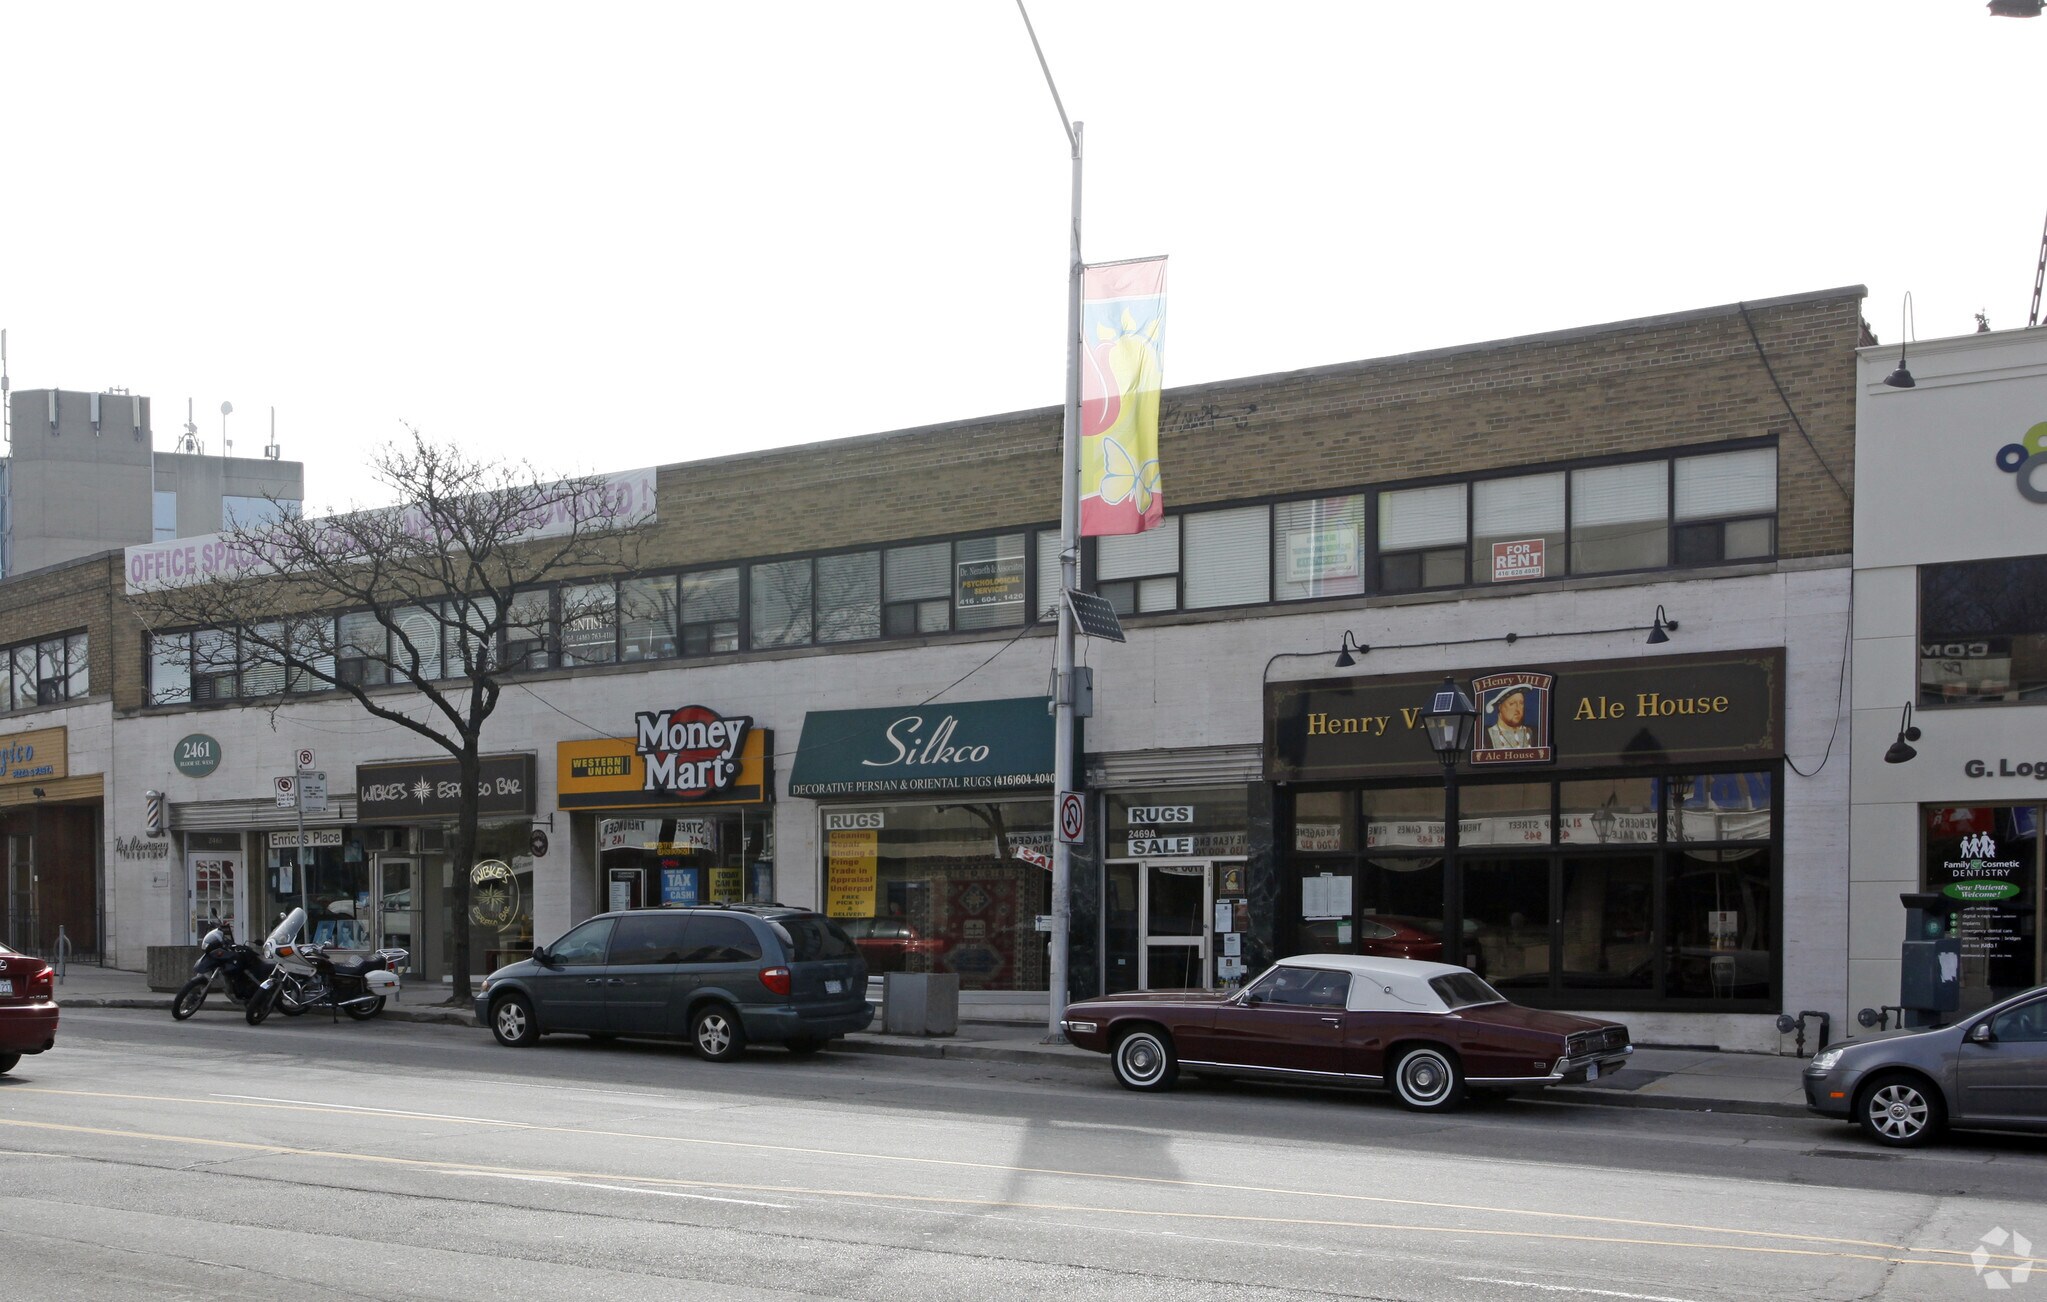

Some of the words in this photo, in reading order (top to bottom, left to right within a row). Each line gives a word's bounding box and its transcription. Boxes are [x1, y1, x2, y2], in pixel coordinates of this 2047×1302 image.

[1506, 544, 1530, 554] FOR
[130, 546, 196, 583] OFFICE
[1496, 552, 1541, 568] RENT
[960, 568, 969, 576] Dr.
[991, 564, 996, 573] &
[962, 576, 1020, 588] PSYCHOLOGICAL
[974, 585, 1008, 595] SERVICES
[1483, 676, 1515, 688] Henry
[1517, 675, 1539, 685] VIII
[1574, 696, 1625, 722] Ale
[1637, 692, 1729, 718] House
[1308, 712, 1390, 736] Henry
[637, 714, 745, 759] Money
[862, 715, 989, 766] Silkco
[183, 741, 210, 759] 2461
[1485, 752, 1501, 760] Ale
[1504, 750, 1535, 760] House
[573, 758, 621, 767] WESTERN
[1965, 759, 1993, 778] G.
[587, 767, 621, 775] UNION
[645, 754, 727, 790] Mart
[496, 777, 521, 794] BAR
[793, 782, 854, 795] DECORATIVE
[856, 780, 897, 792] PERSIAN
[899, 780, 907, 789] &
[909, 777, 960, 790] ORIENTAL
[963, 776, 992, 787] RUGS
[1132, 807, 1189, 822] RUGS
[830, 814, 880, 828] RUGS
[313, 830, 341, 844] Place
[1128, 830, 1156, 839] 2469A
[831, 841, 860, 849] Repair
[1133, 838, 1189, 854] SALE
[832, 850, 865, 858] Binding
[831, 859, 859, 867] Fringe
[1944, 861, 1971, 870] Family
[1981, 860, 2020, 869] Cosmetic
[472, 864, 511, 885] WIBKE'S
[717, 871, 739, 879] TODAY
[1952, 869, 2011, 877] DENTISTRY
[668, 873, 691, 887] TAX
[715, 880, 730, 888] CAN
[831, 876, 872, 884] Appraisal
[831, 885, 873, 893] Underpad
[670, 891, 695, 900] CASH!
